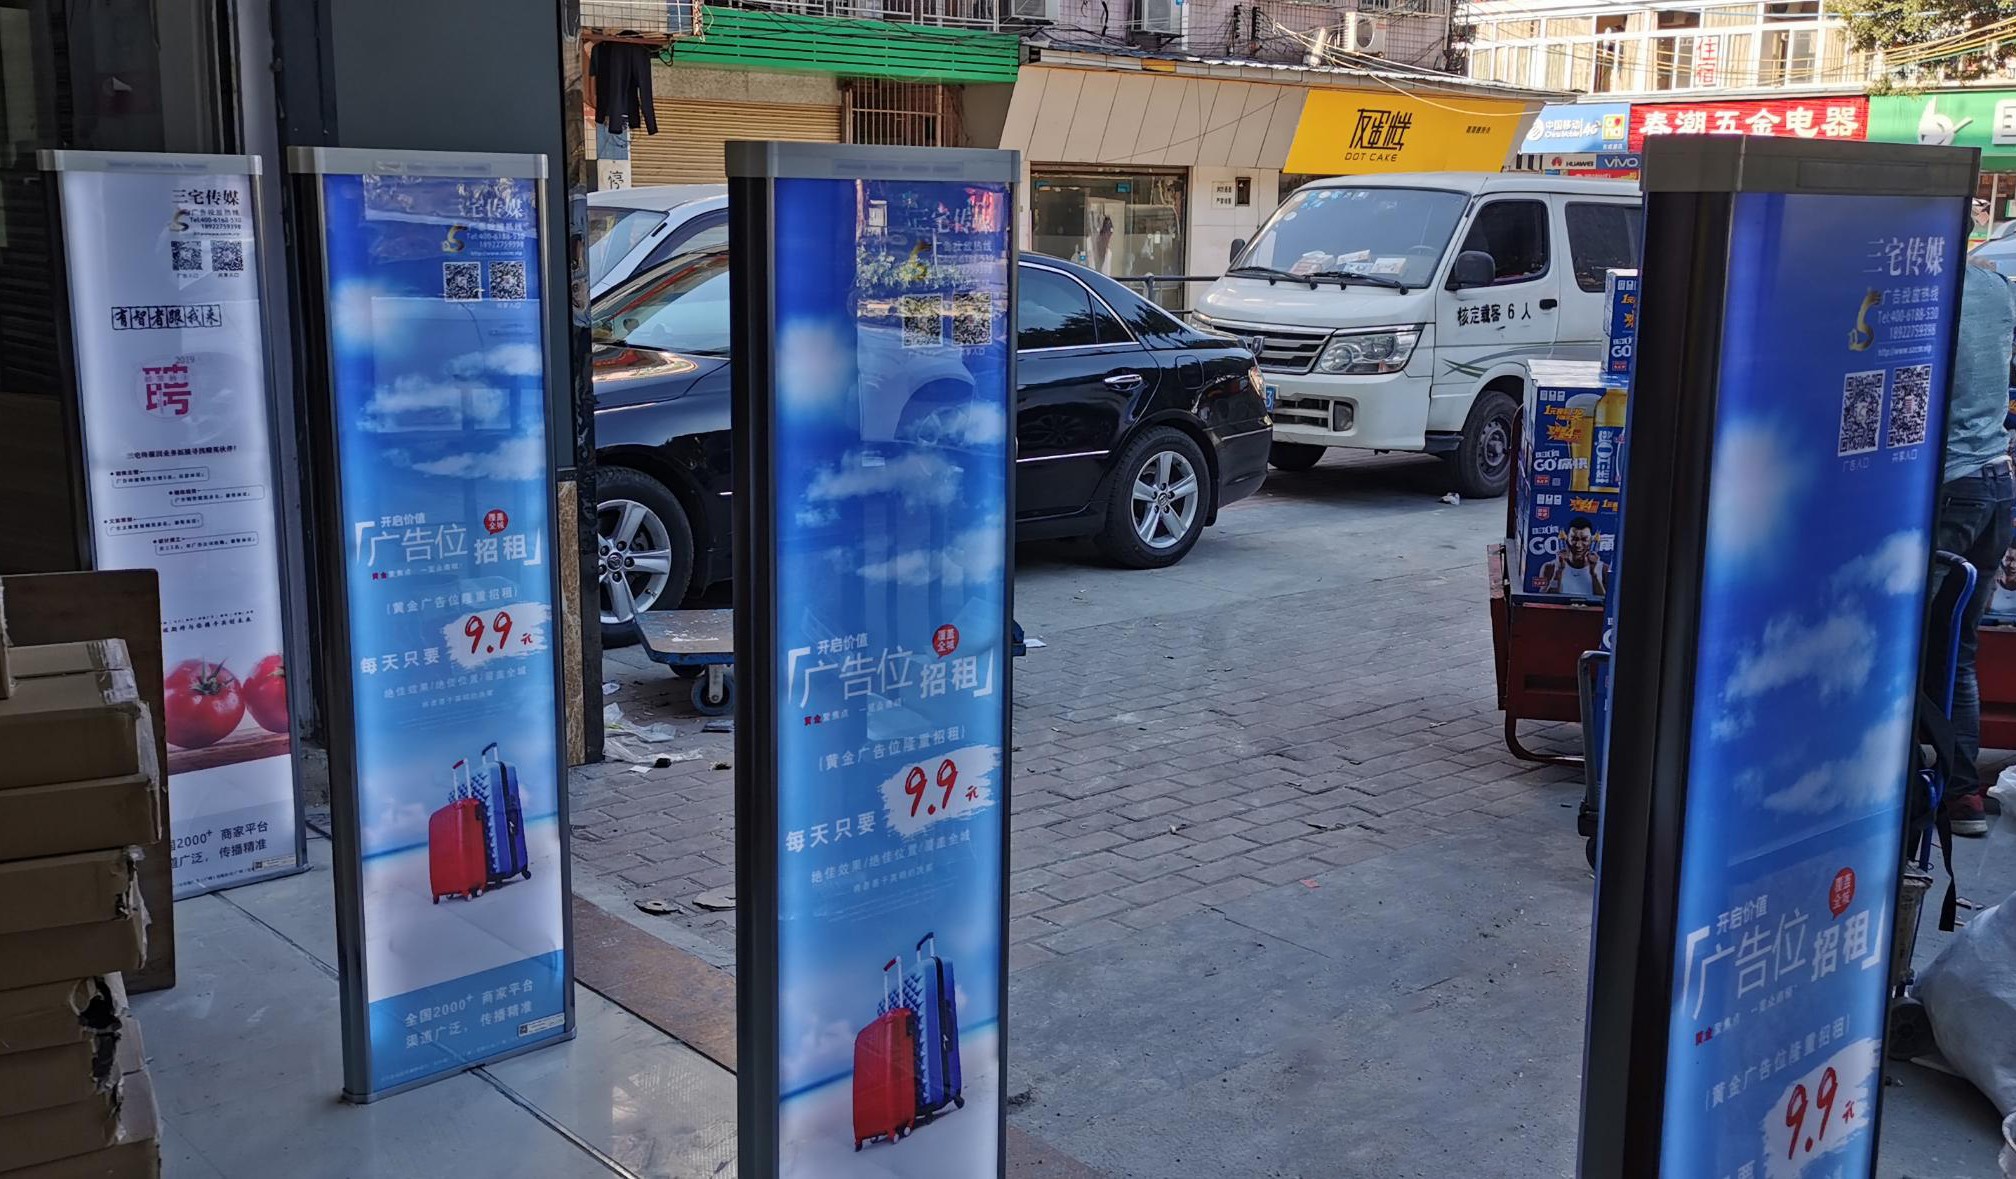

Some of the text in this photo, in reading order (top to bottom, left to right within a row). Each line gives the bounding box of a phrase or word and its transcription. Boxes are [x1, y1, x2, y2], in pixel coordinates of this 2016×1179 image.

[1639, 106, 1859, 138] 春潮五金电器
[1344, 152, 1399, 162] DOT CAKE
[172, 189, 240, 206] 三宅传媒
[1862, 236, 1945, 277] 三宅传媒
[1457, 302, 1532, 327] 核定载客 6 人
[1611, 345, 1632, 358] GO
[381, 512, 426, 528] 开启价值
[474, 534, 528, 565] 招租
[1529, 535, 1560, 555] GO
[464, 611, 513, 655] 9.9
[817, 632, 869, 655] 开启价值
[360, 647, 441, 675] 每天只要
[920, 655, 979, 699] 招租
[904, 758, 959, 817] 9.9
[220, 820, 269, 841] 商家平台
[785, 811, 877, 853] 每天只要
[218, 838, 268, 860] 传播精准
[1716, 895, 1769, 936] 开启价值
[1811, 909, 1870, 983] 招租
[481, 979, 534, 1005] 商家平台
[480, 1000, 533, 1026] 传播精准
[1785, 1066, 1839, 1160] 9.9
